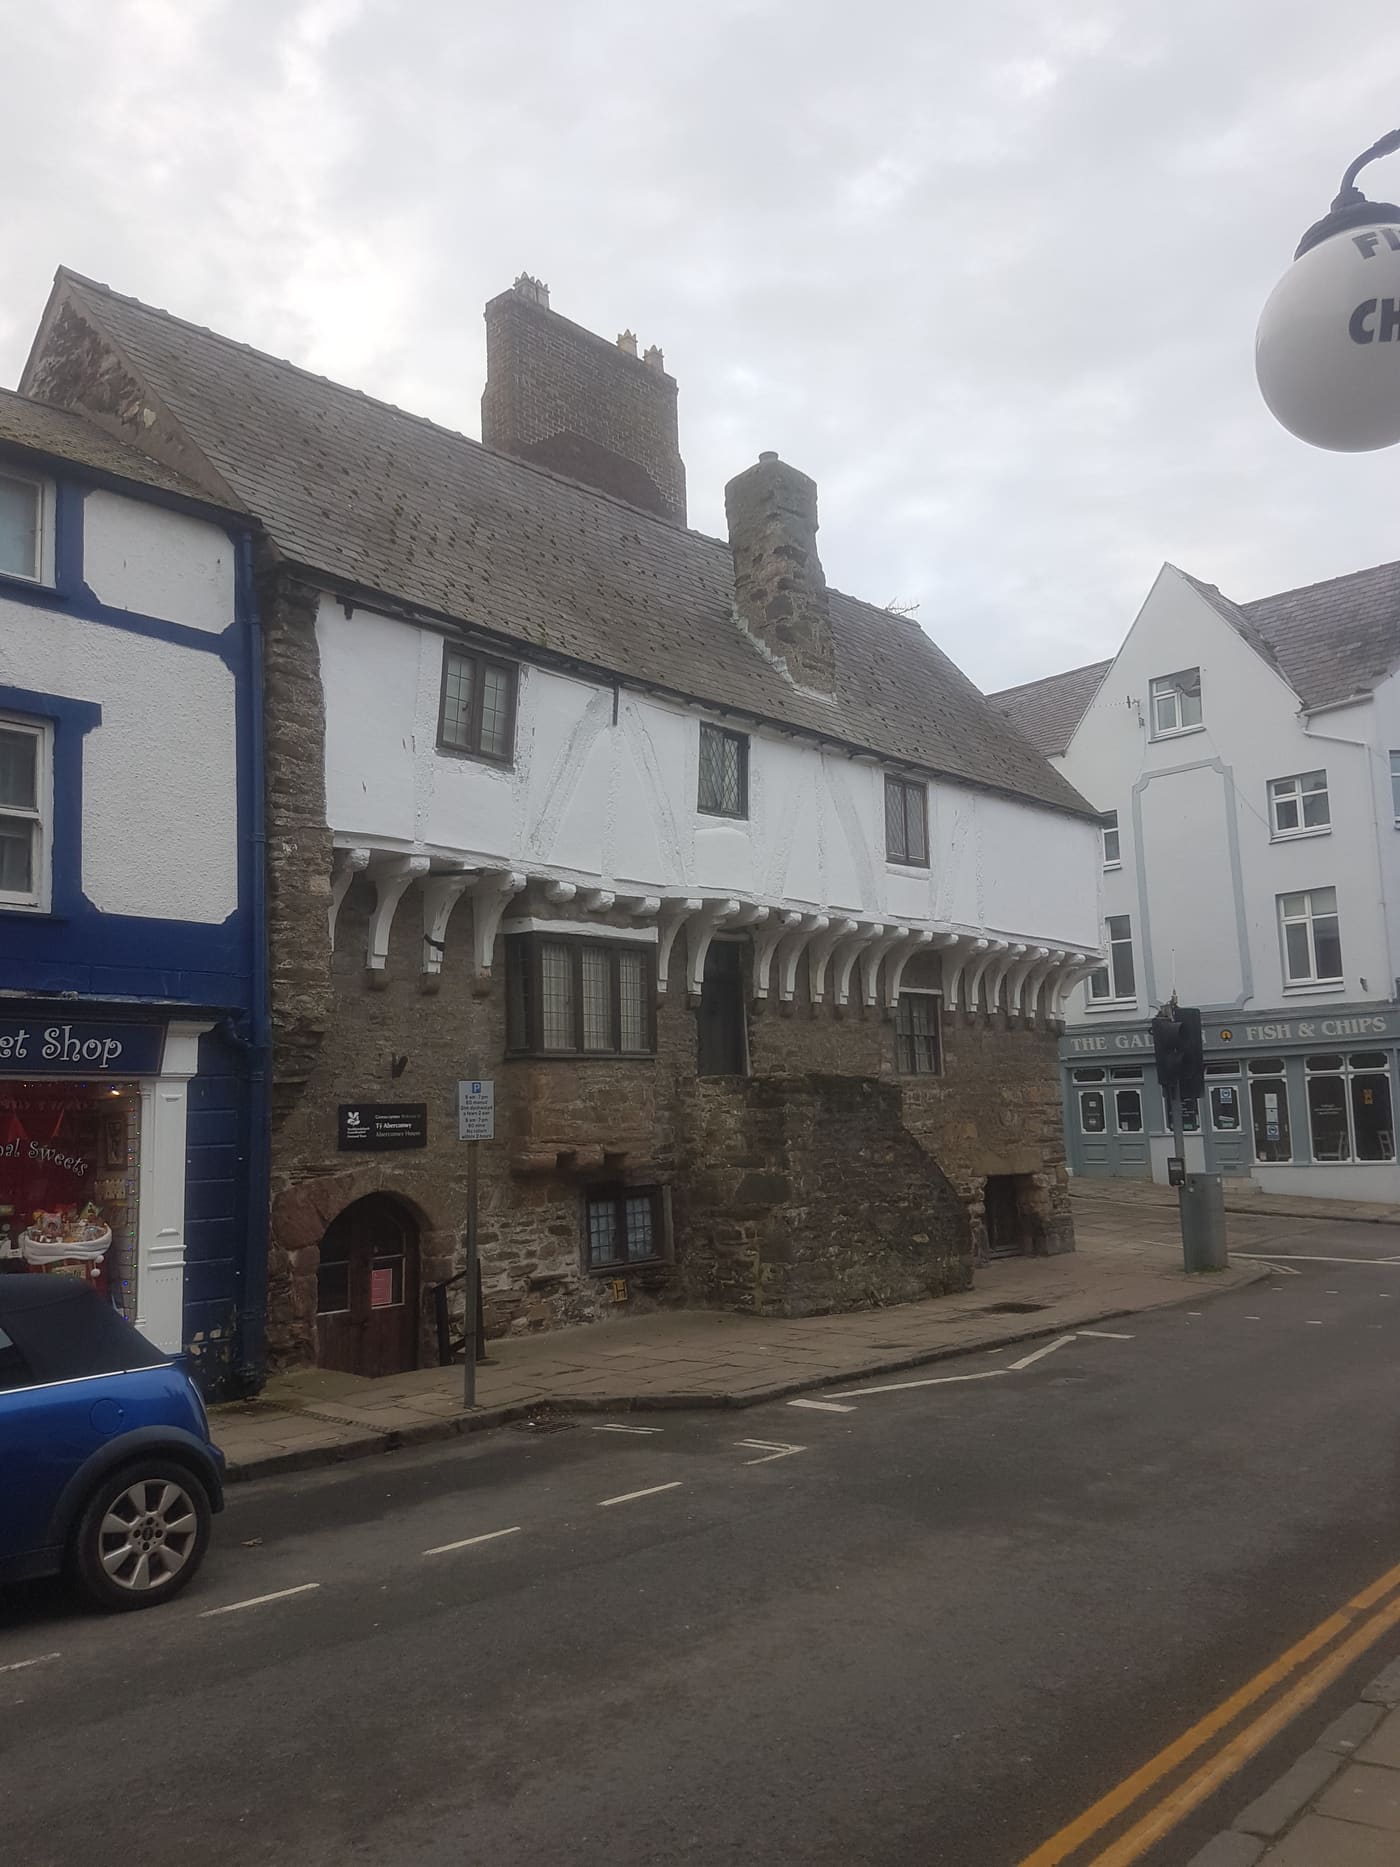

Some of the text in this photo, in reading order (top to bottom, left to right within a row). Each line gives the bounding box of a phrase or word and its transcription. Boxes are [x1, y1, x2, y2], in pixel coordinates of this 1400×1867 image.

[41, 1025, 123, 1068] Shop
[1070, 1036, 1107, 1052] THE
[1245, 1023, 1292, 1041] FISH
[1298, 1022, 1316, 1038] &
[1321, 1016, 1387, 1036] CHIPS
[28, 1140, 89, 1177] Sweets
[615, 1282, 626, 1299] H
